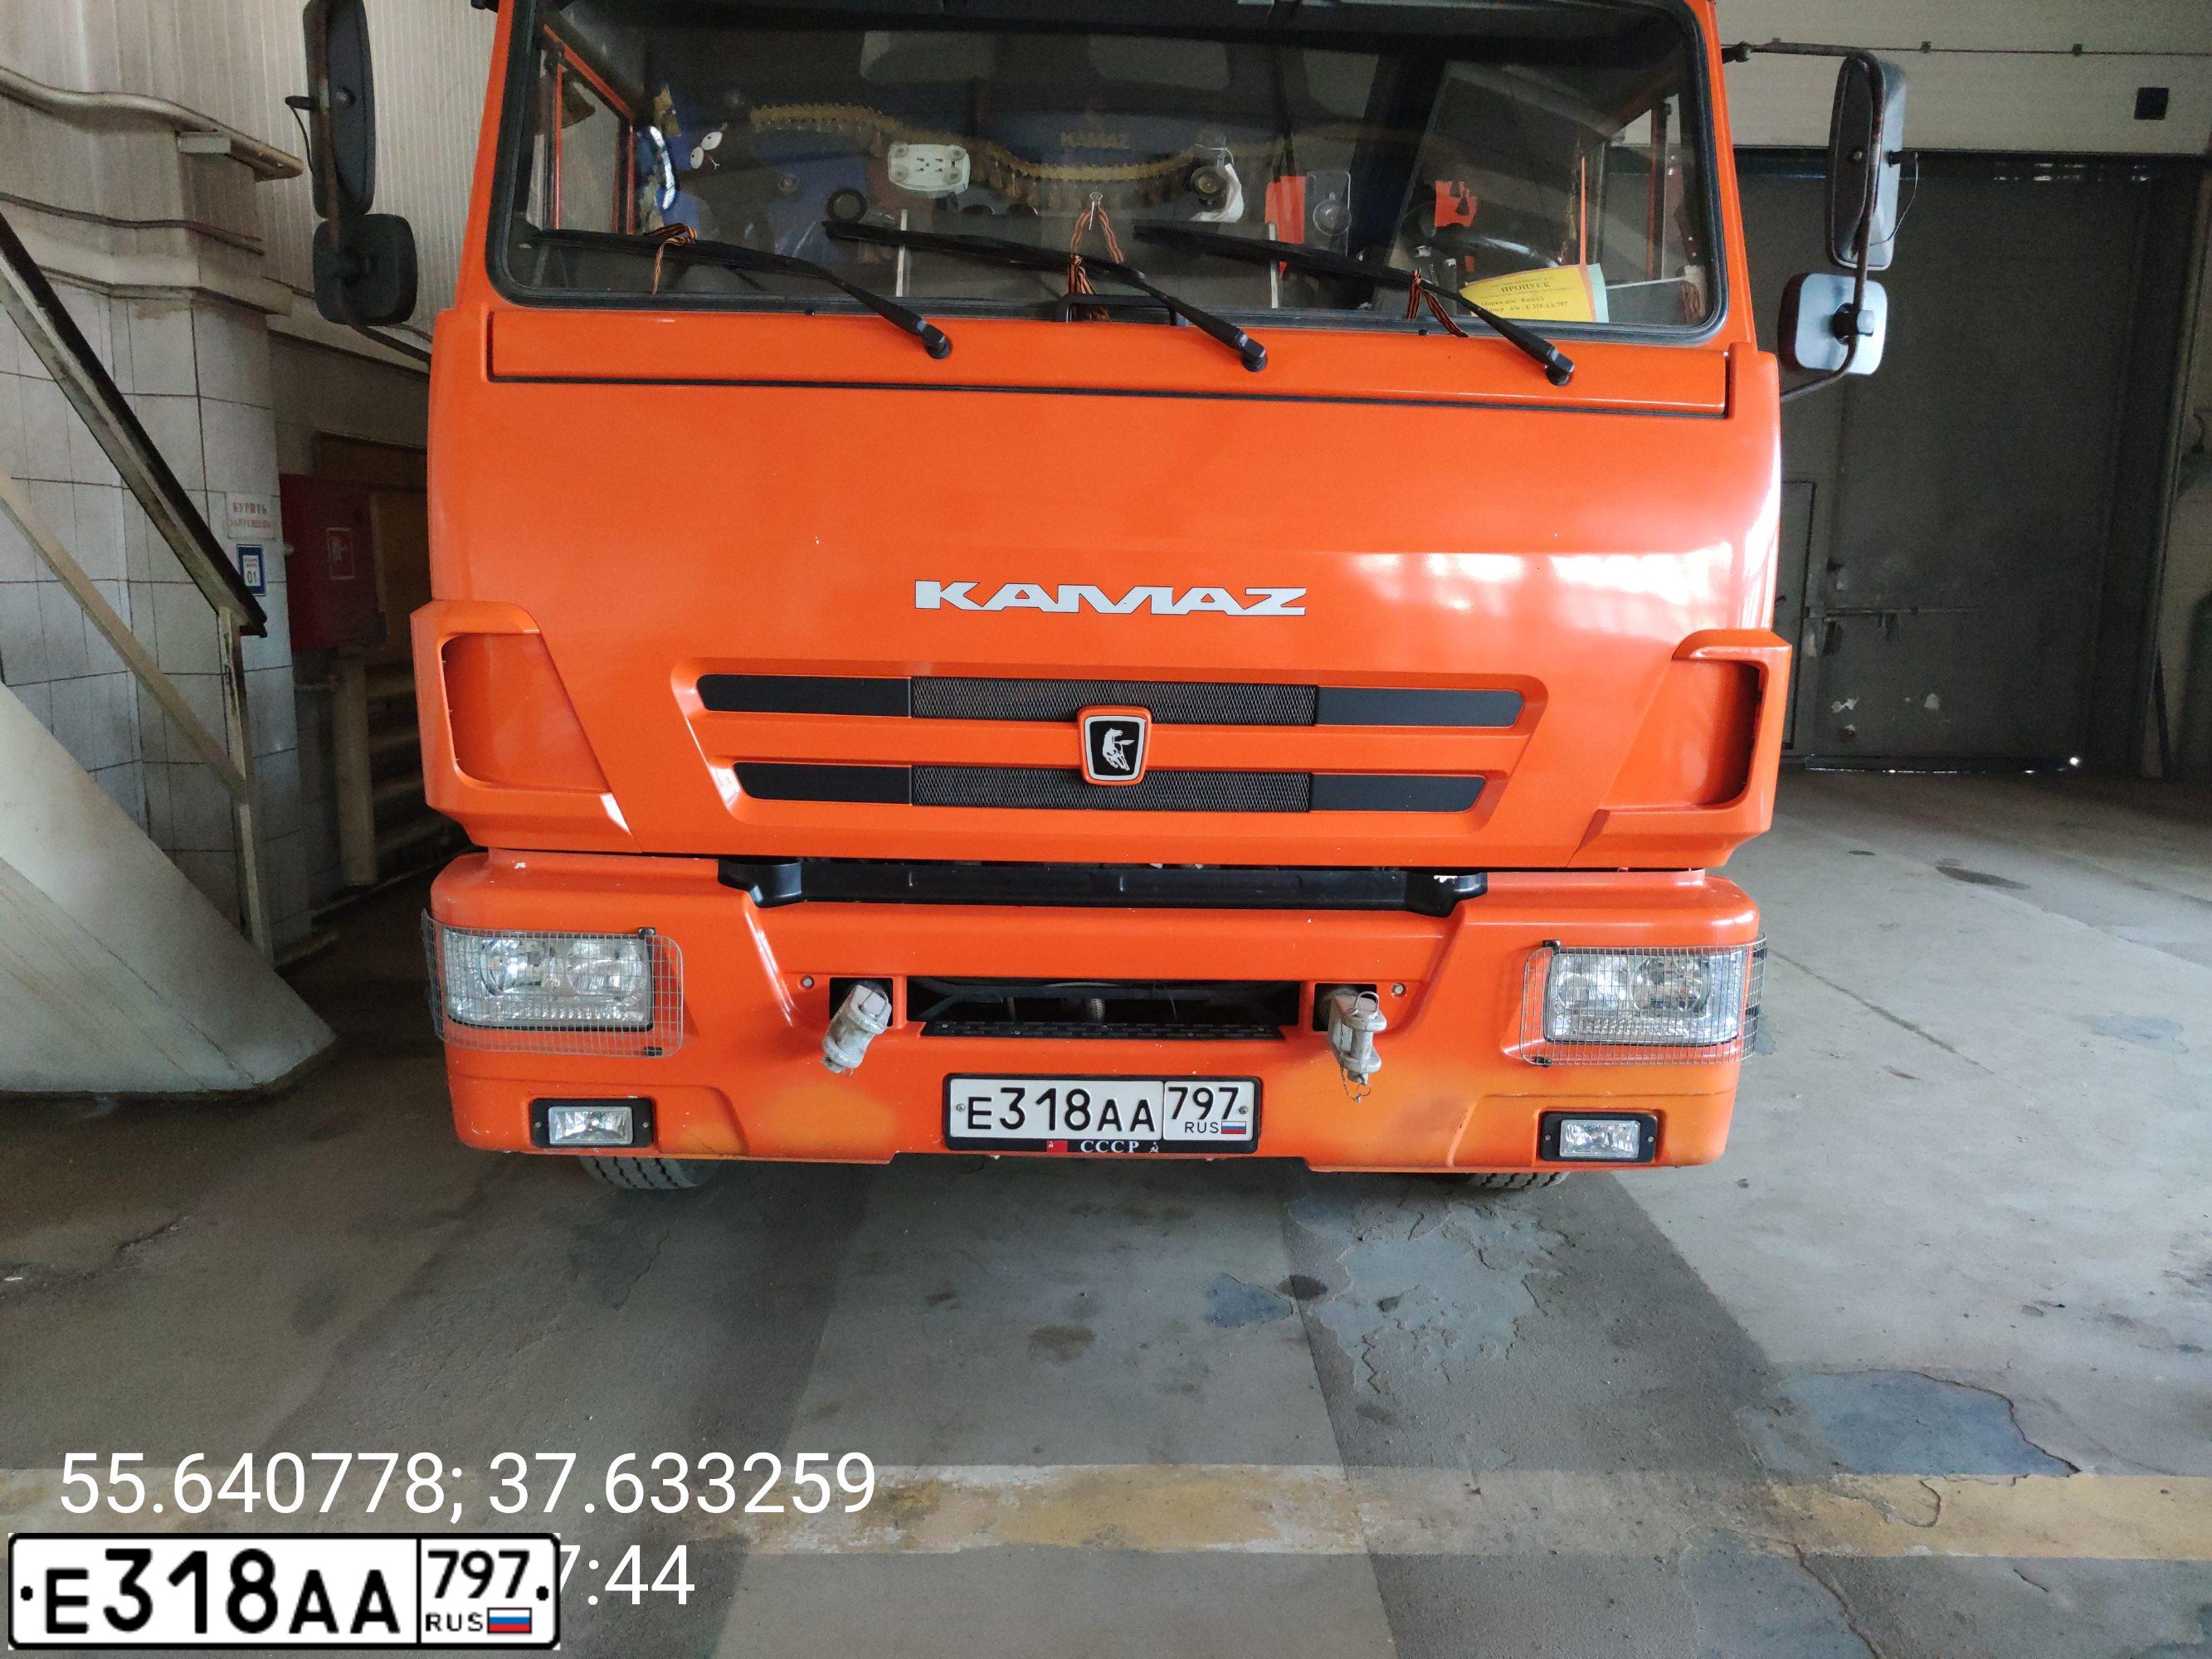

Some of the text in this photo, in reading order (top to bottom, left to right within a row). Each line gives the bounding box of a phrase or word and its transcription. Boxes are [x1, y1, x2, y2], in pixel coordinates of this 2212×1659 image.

[1501, 281, 1551, 293] ПРОПУСК
[232, 502, 267, 514] КУРИТЬ
[247, 571, 257, 583] 01
[915, 580, 1307, 615] KAMAZ
[967, 1087, 1240, 1131] Е318АА 797
[1184, 1121, 1219, 1134] RUS
[1080, 1141, 1139, 1153] СССР
